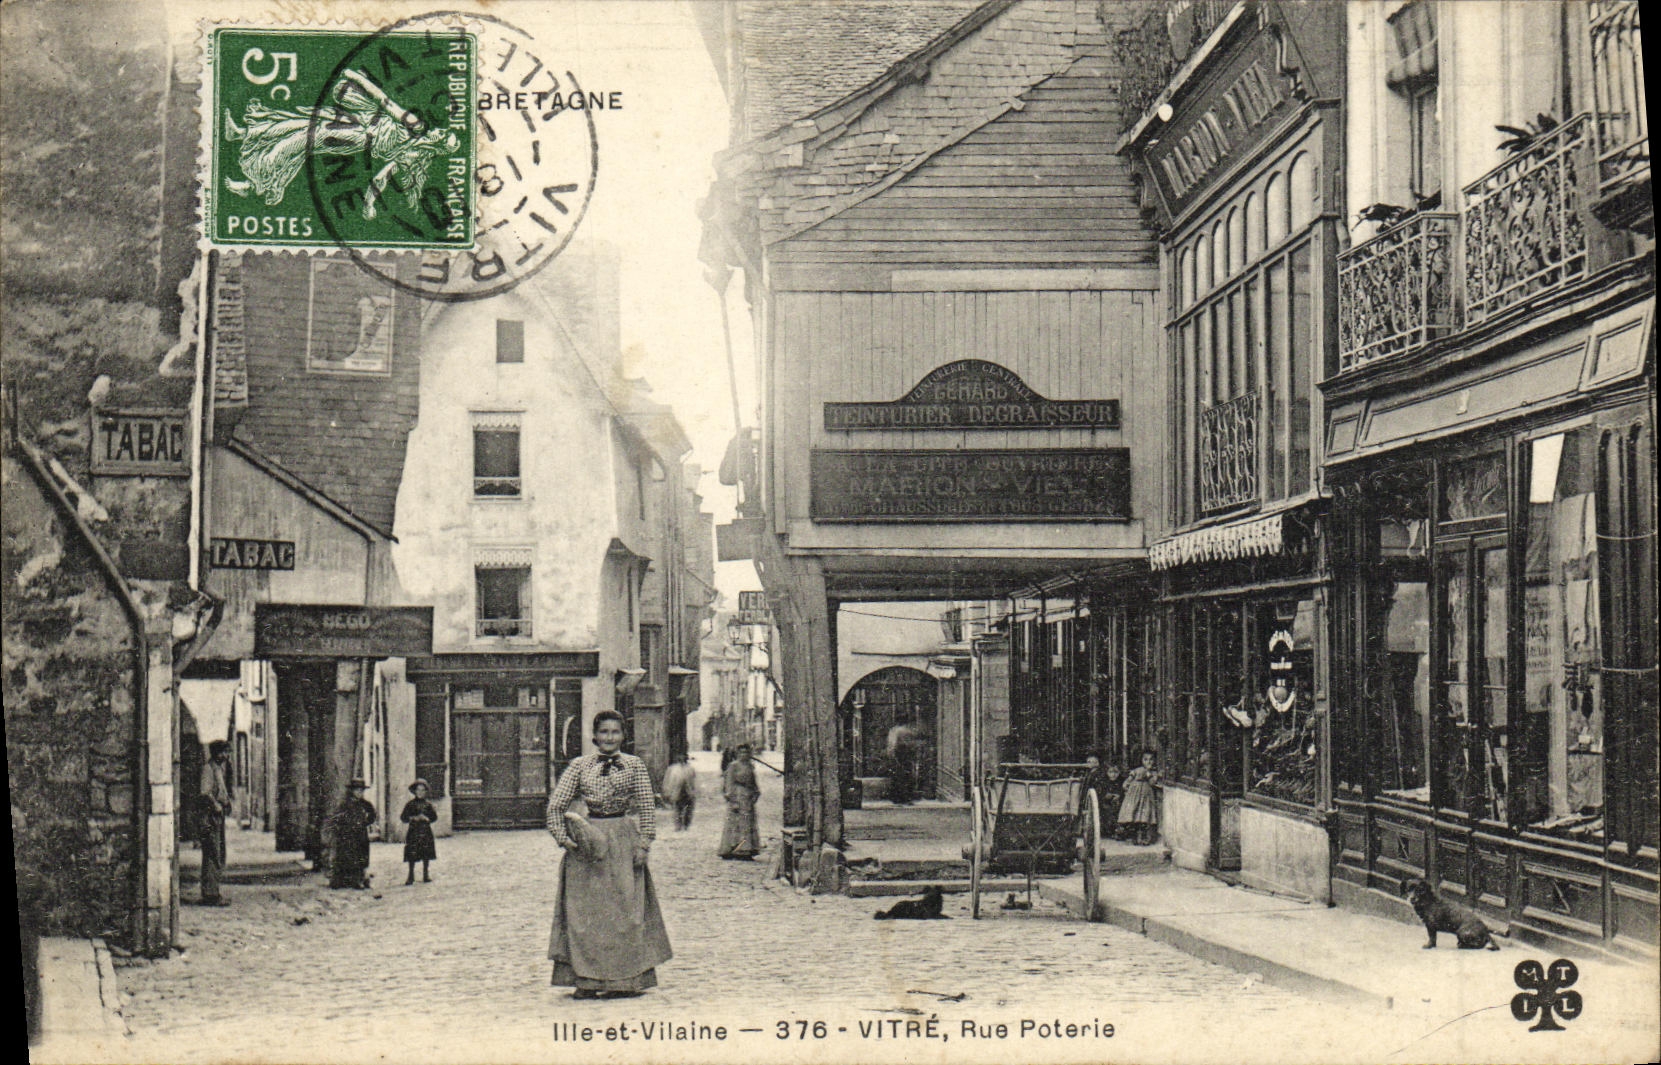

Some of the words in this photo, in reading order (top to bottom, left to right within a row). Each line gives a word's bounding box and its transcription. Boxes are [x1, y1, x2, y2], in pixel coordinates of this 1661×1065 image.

[227, 215, 313, 237] POSTES
[102, 422, 184, 462] TABAC
[211, 542, 294, 570] TABAC
